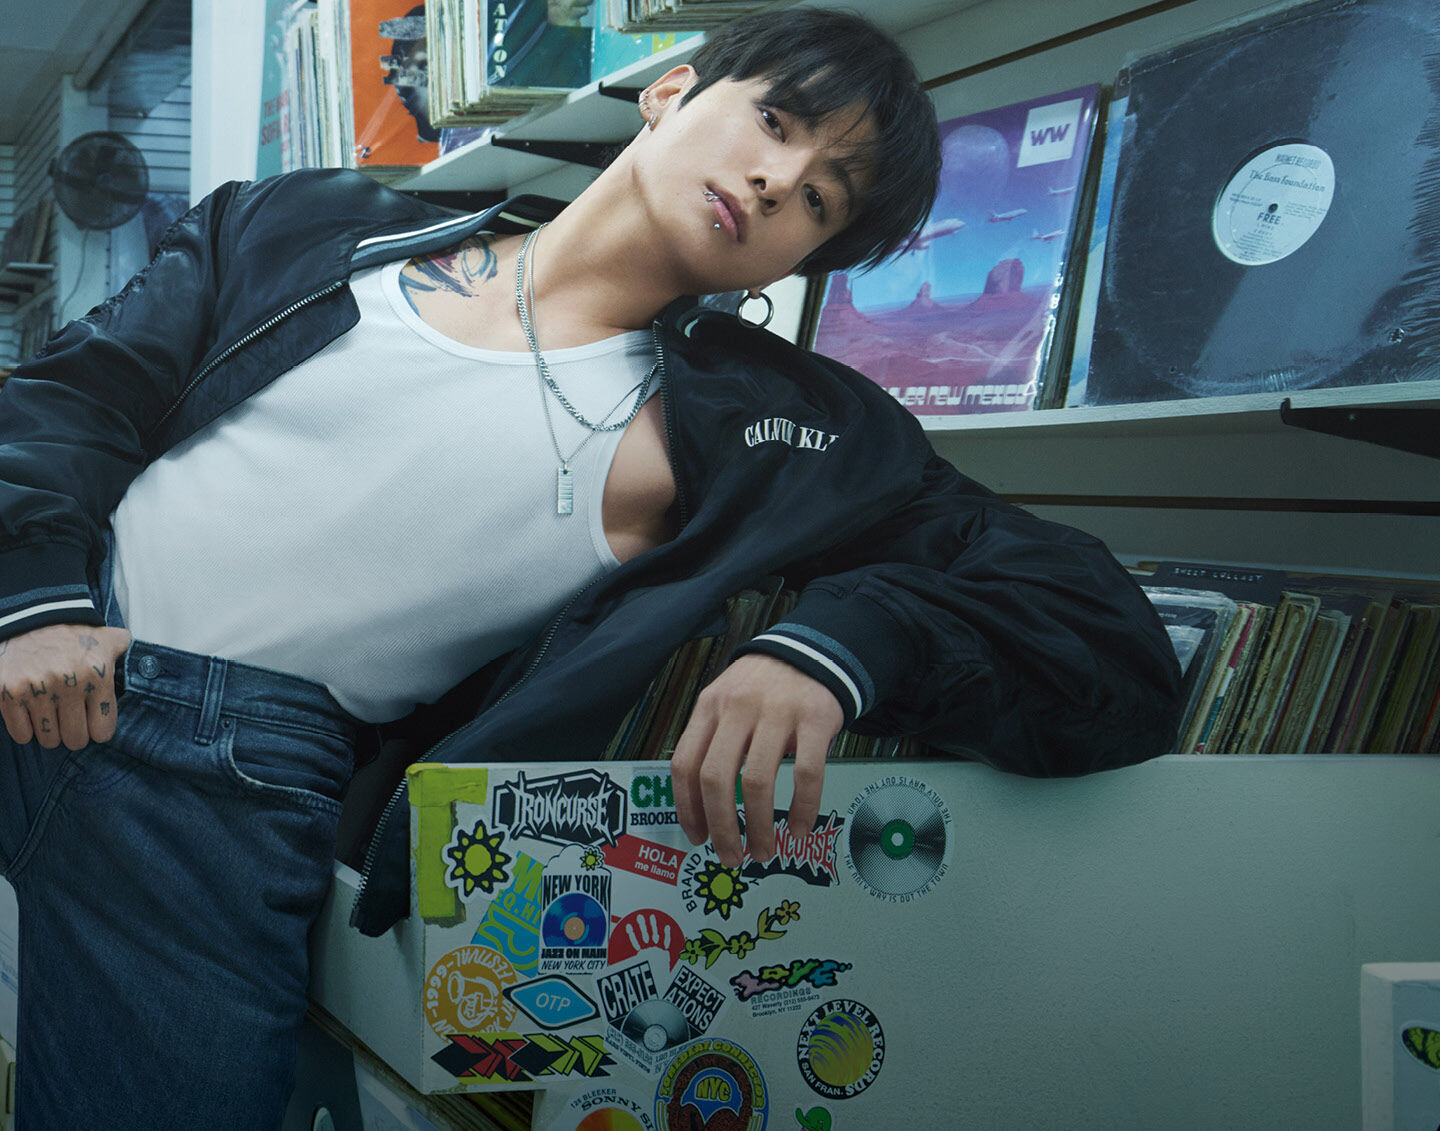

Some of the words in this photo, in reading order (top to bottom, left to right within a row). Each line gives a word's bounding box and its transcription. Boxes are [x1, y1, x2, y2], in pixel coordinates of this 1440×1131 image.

[1031, 123, 1071, 147] WW
[1257, 211, 1282, 226] FREE
[506, 772, 616, 847] IRONCURSE
[638, 844, 679, 869] HOLA
[634, 861, 650, 871] me
[650, 863, 676, 880] llamo
[681, 853, 702, 912] BRAND
[543, 875, 572, 912] NEW
[575, 875, 609, 913] YORK
[889, 894, 897, 903] IS
[917, 886, 932, 898] THE
[541, 947, 564, 959] JAZZ
[566, 948, 580, 959] ON
[582, 948, 607, 959] MAIN
[541, 960, 562, 970] NEW
[563, 960, 585, 970] YORK
[587, 959, 608, 970] CITY
[535, 992, 572, 1012] OTP
[601, 963, 659, 1018] CRATE
[673, 967, 726, 1012] EXPECT
[751, 987, 812, 1005] RECORDINGS
[663, 986, 713, 1030] ATIONS
[752, 1010, 777, 1018] Brooklyn,
[822, 999, 873, 1026] LEVEL
[798, 1011, 821, 1060] NEXT
[844, 1022, 885, 1097] RECORDS
[696, 1077, 731, 1102] NYC
[801, 1061, 817, 1083] SAN
[814, 1081, 844, 1096] FRAN.
[581, 1095, 642, 1113] SONNY
[582, 1088, 617, 1101] BLEEKER
